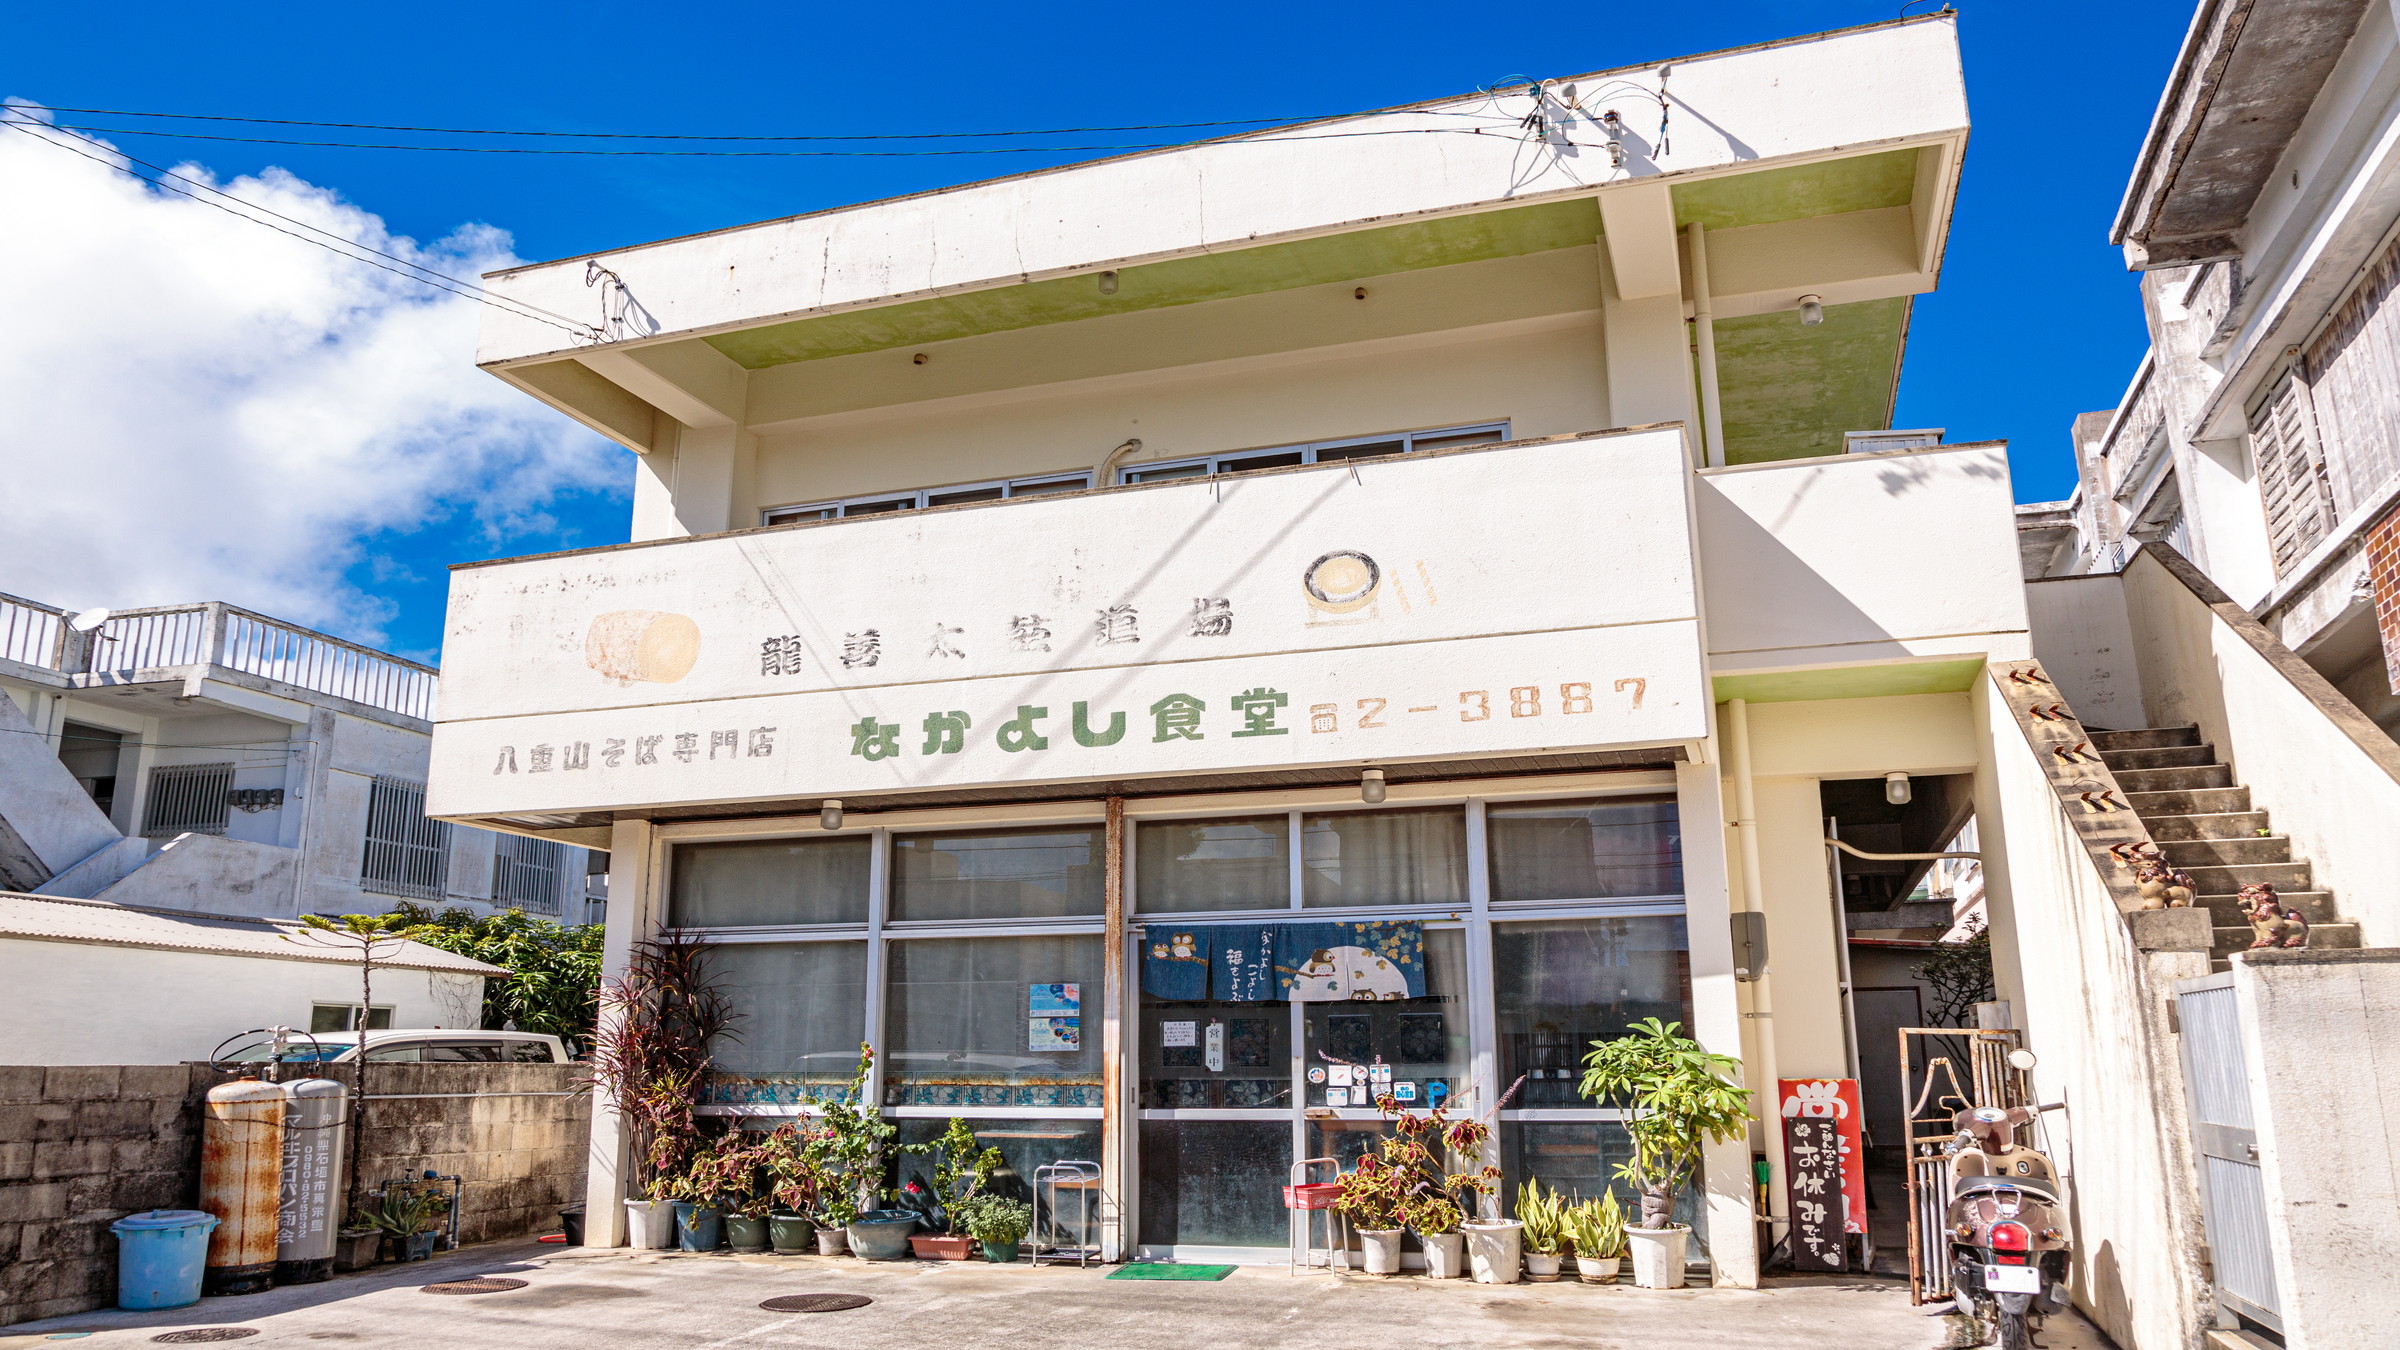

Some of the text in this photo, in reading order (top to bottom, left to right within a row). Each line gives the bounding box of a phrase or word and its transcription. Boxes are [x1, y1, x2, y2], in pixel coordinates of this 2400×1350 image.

[493, 726, 778, 775] 八重山そば専門店
[850, 688, 1289, 762] なかよし食堂
[1208, 1028, 1220, 1067] 営業中
[1818, 1123, 1837, 1179] ごめんなさい
